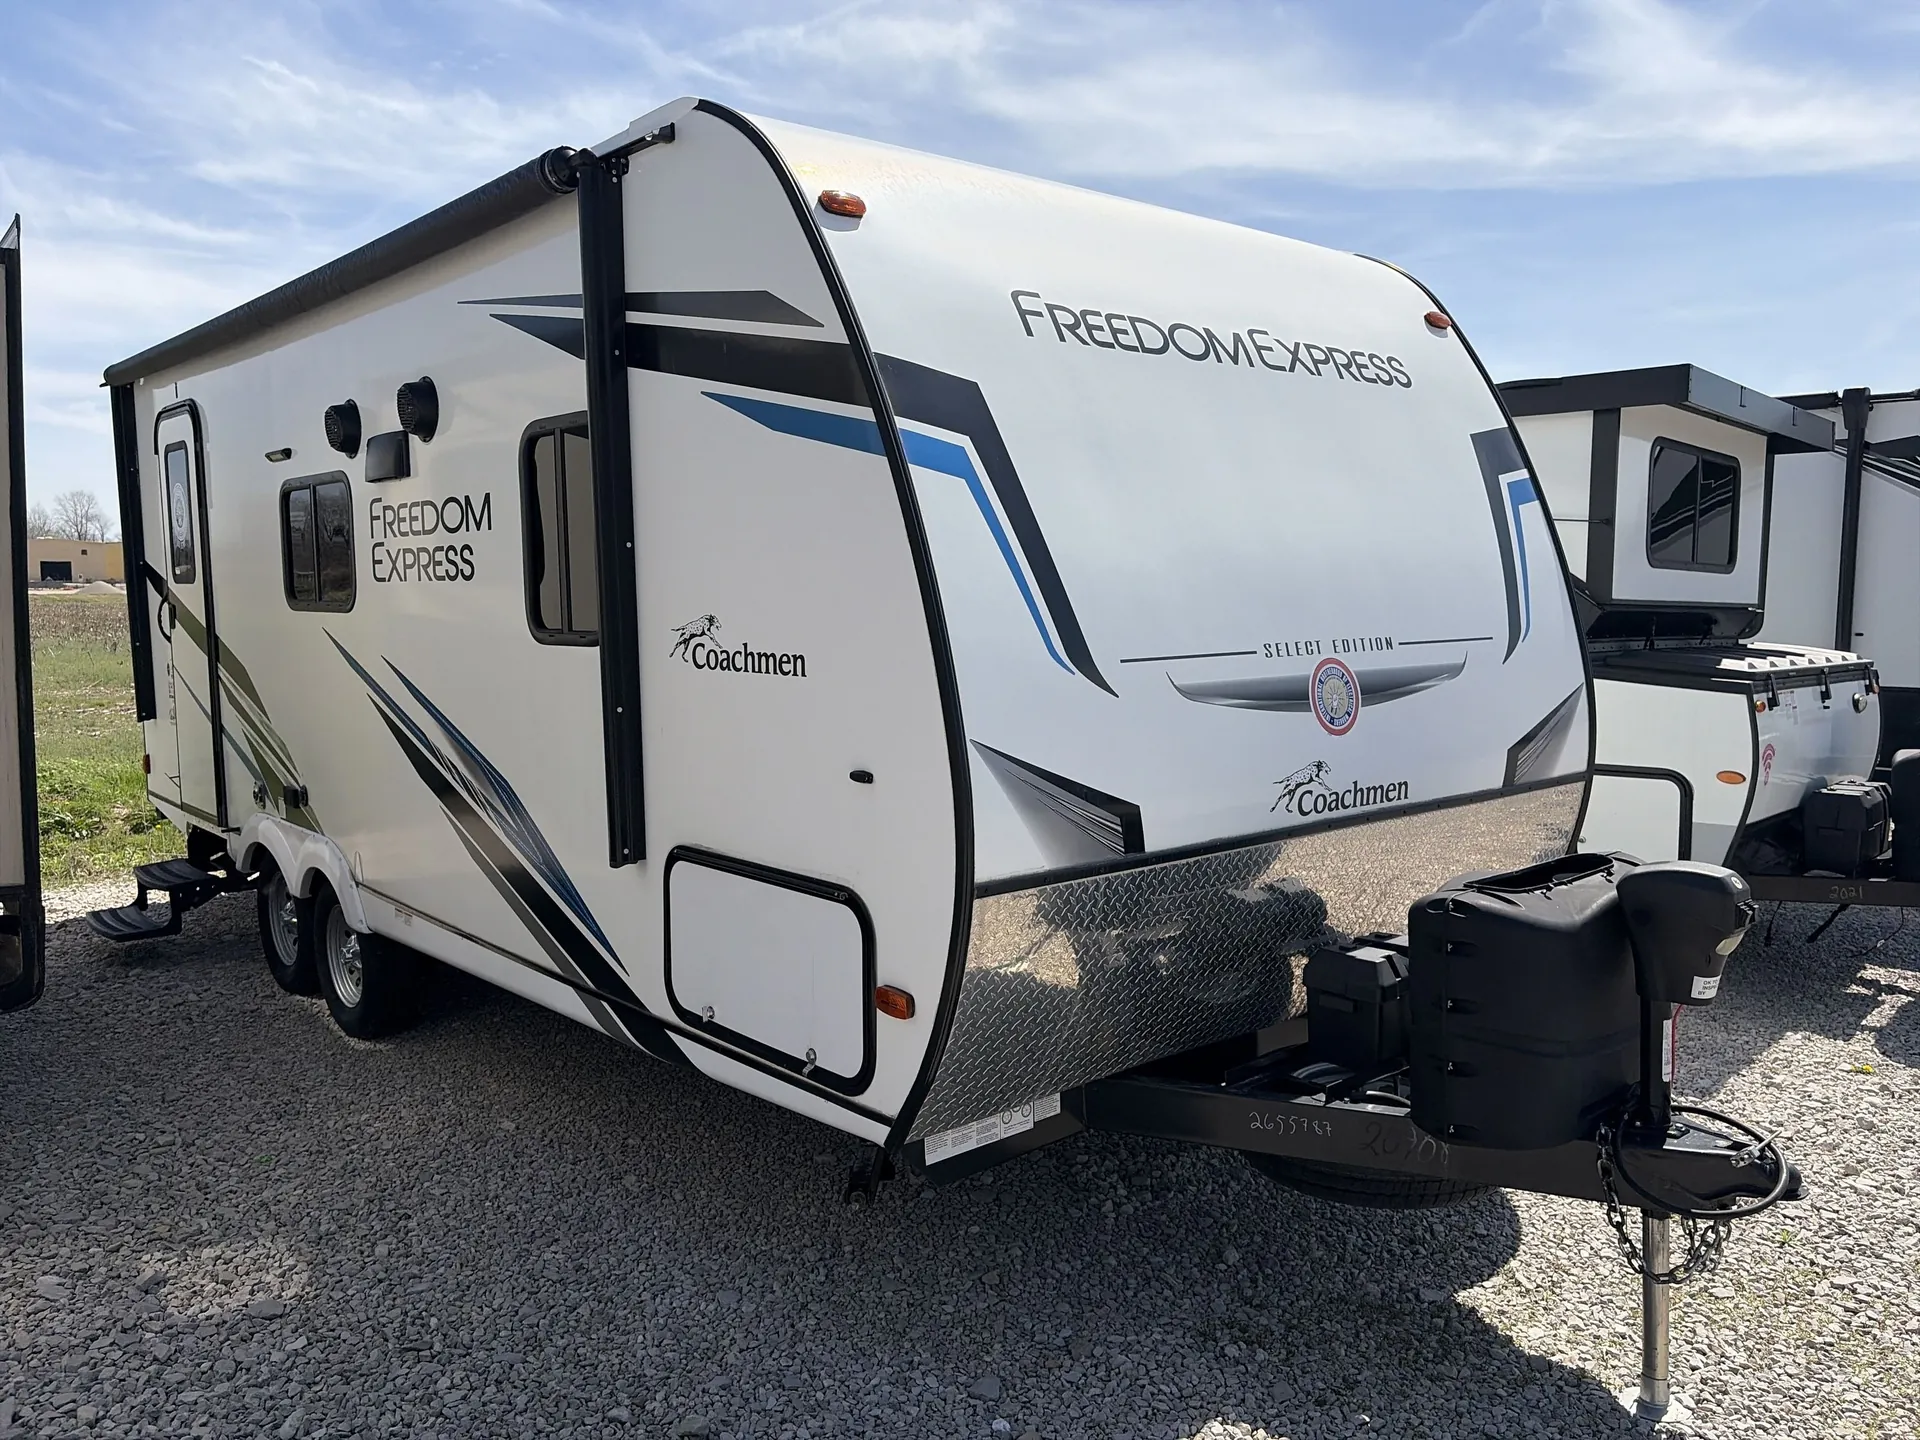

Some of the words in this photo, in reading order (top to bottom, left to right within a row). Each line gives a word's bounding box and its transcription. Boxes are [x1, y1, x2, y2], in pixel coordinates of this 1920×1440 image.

[369, 492, 492, 539] FREEDOM
[372, 542, 475, 583] EXPRESS
[692, 642, 807, 678] Coachmen
[1263, 640, 1322, 659] SELECT
[1332, 636, 1394, 654] EDITION
[1297, 780, 1409, 817] Coachmen
[1829, 885, 1863, 900] 2021
[1249, 1111, 1332, 1137] 2655787
